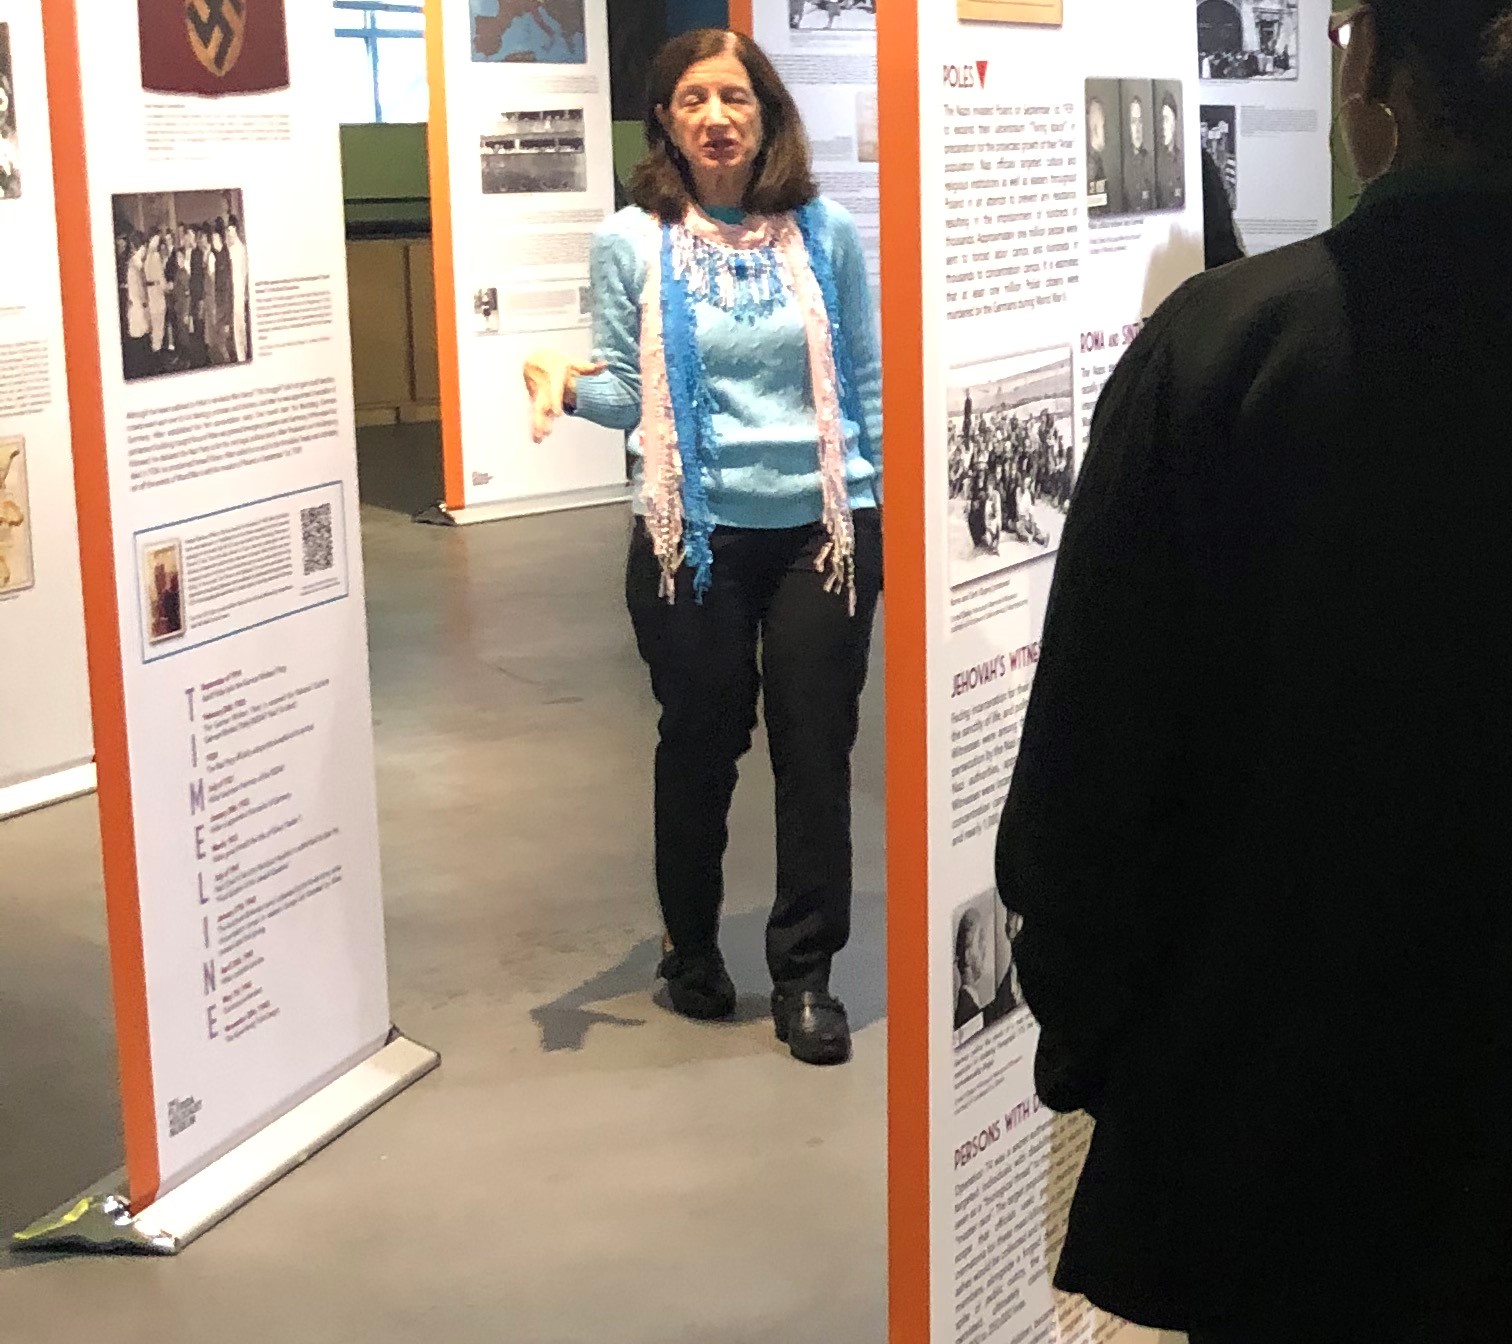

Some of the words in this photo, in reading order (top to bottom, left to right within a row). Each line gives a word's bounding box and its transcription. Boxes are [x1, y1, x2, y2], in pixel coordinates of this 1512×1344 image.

[942, 64, 975, 88] POLES
[951, 654, 1006, 698] JEHOVAH'S
[954, 1119, 1001, 1171] PERSONS
[1005, 1097, 1030, 1132] WITH
